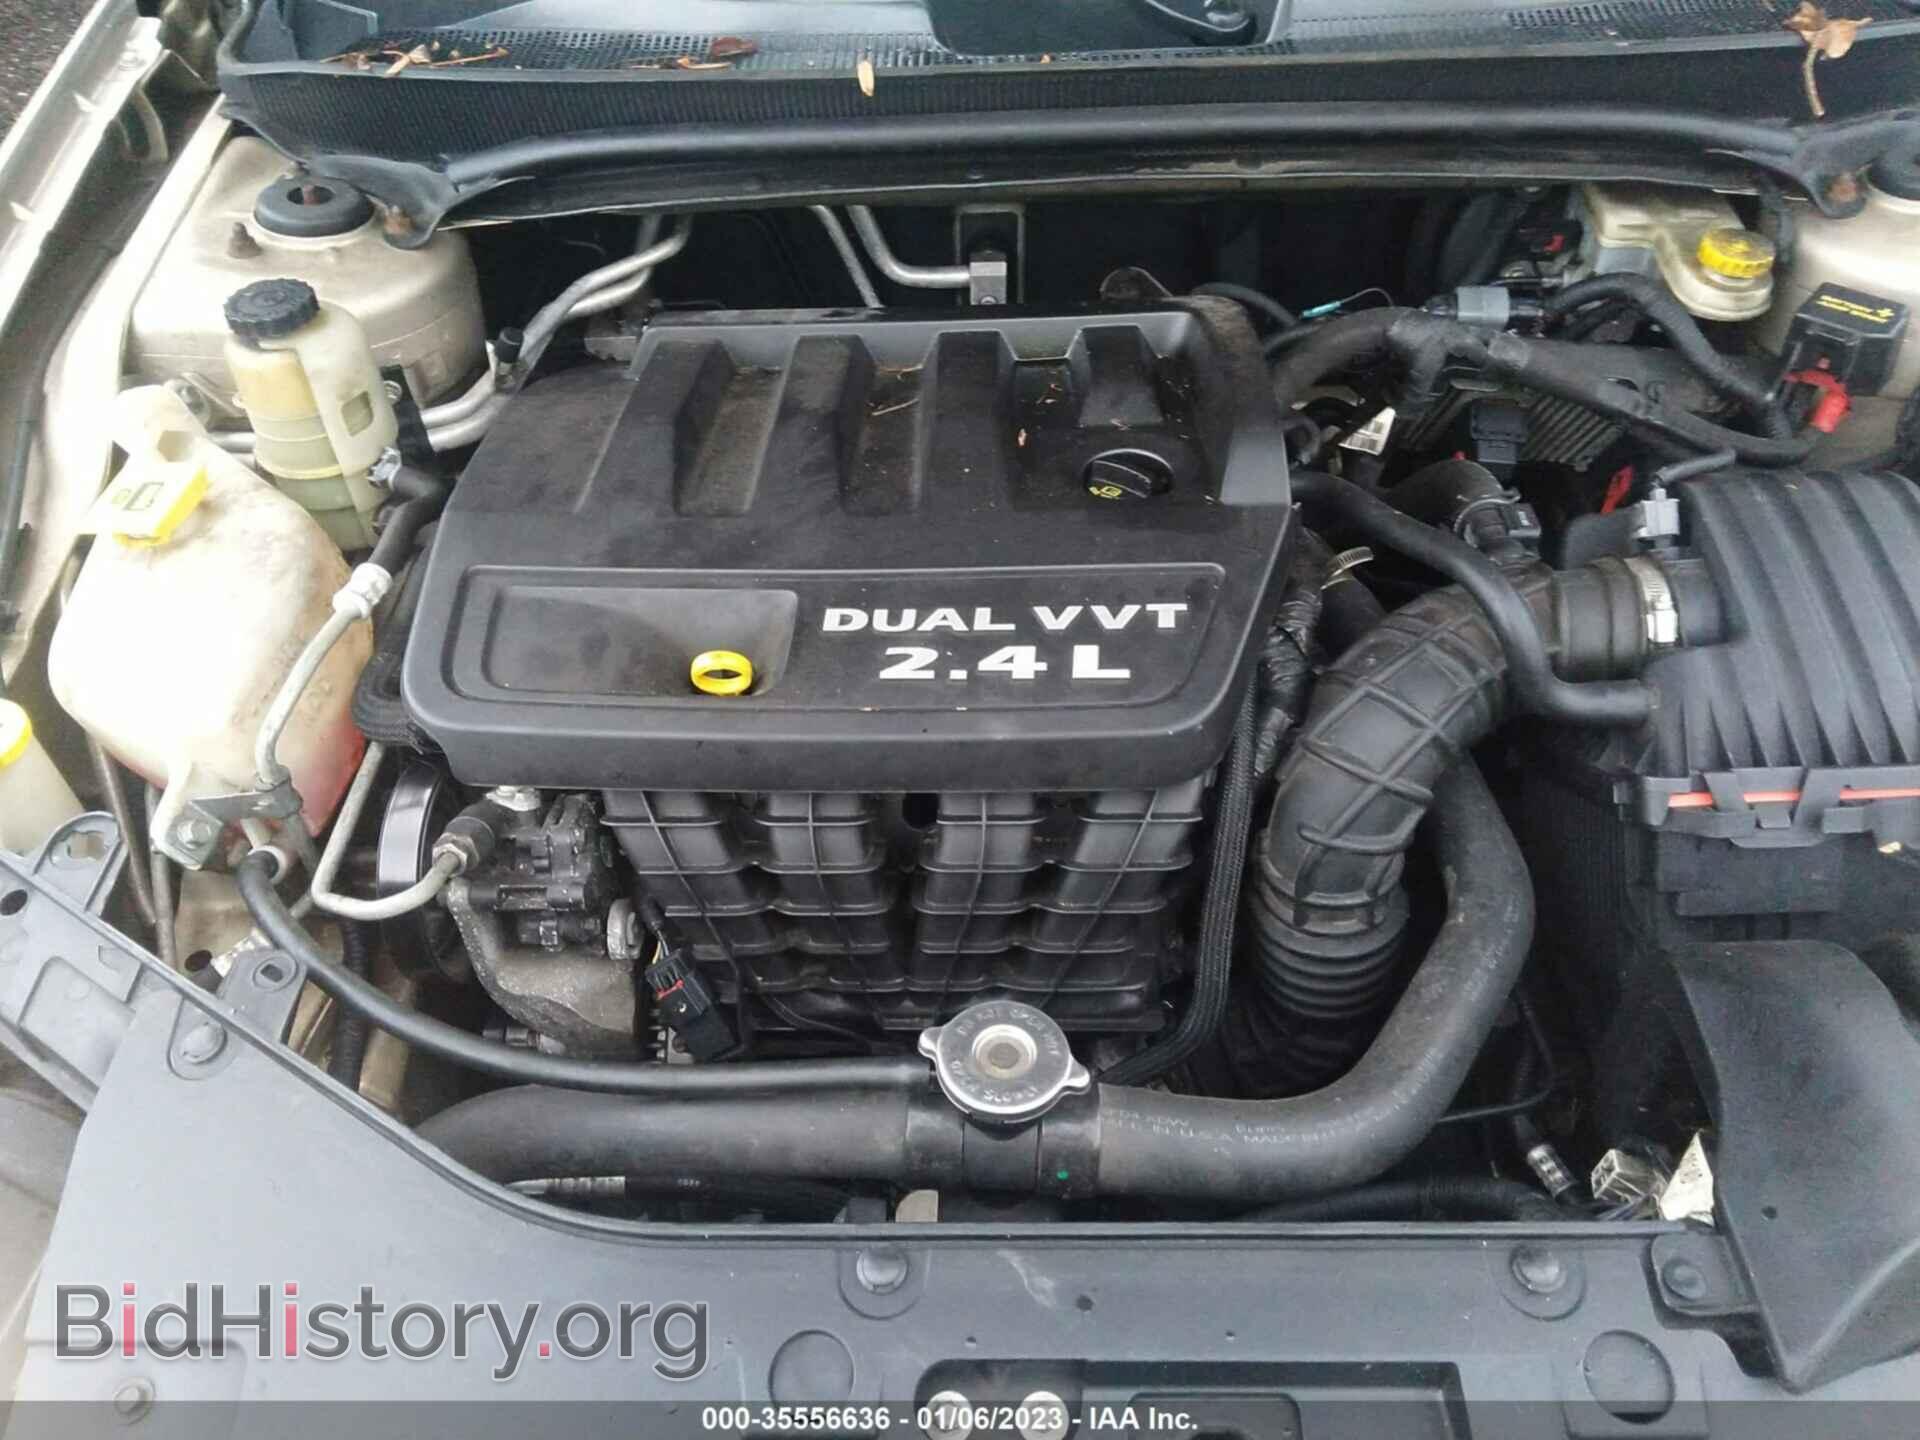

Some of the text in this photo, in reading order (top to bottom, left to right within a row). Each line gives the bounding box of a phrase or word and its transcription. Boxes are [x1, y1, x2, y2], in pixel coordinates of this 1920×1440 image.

[822, 602, 1189, 632] DUAL VVT
[879, 644, 1131, 680] 2.4 L
